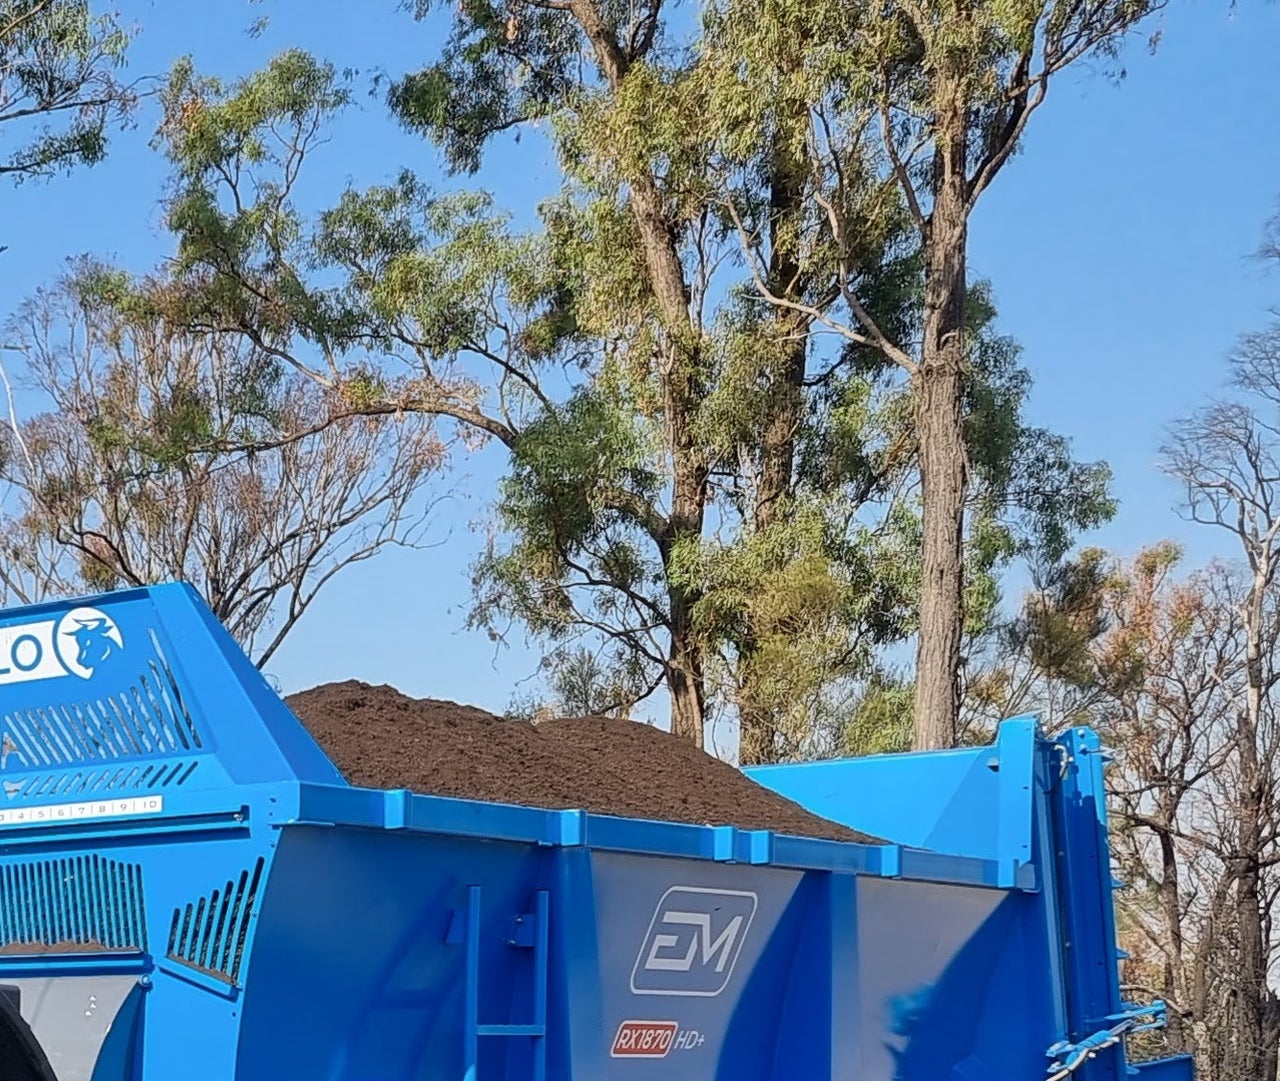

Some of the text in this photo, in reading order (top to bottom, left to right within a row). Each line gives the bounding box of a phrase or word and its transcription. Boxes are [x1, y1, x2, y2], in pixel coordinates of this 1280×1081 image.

[18, 812, 25, 820] 4
[37, 810, 45, 818] 5
[57, 809, 65, 817] 6
[78, 807, 86, 815] 7
[98, 805, 106, 813] 8
[120, 803, 128, 811] 9
[142, 800, 157, 809] 10
[644, 911, 744, 973] EM
[616, 1029, 705, 1050] RX1870 HD+
